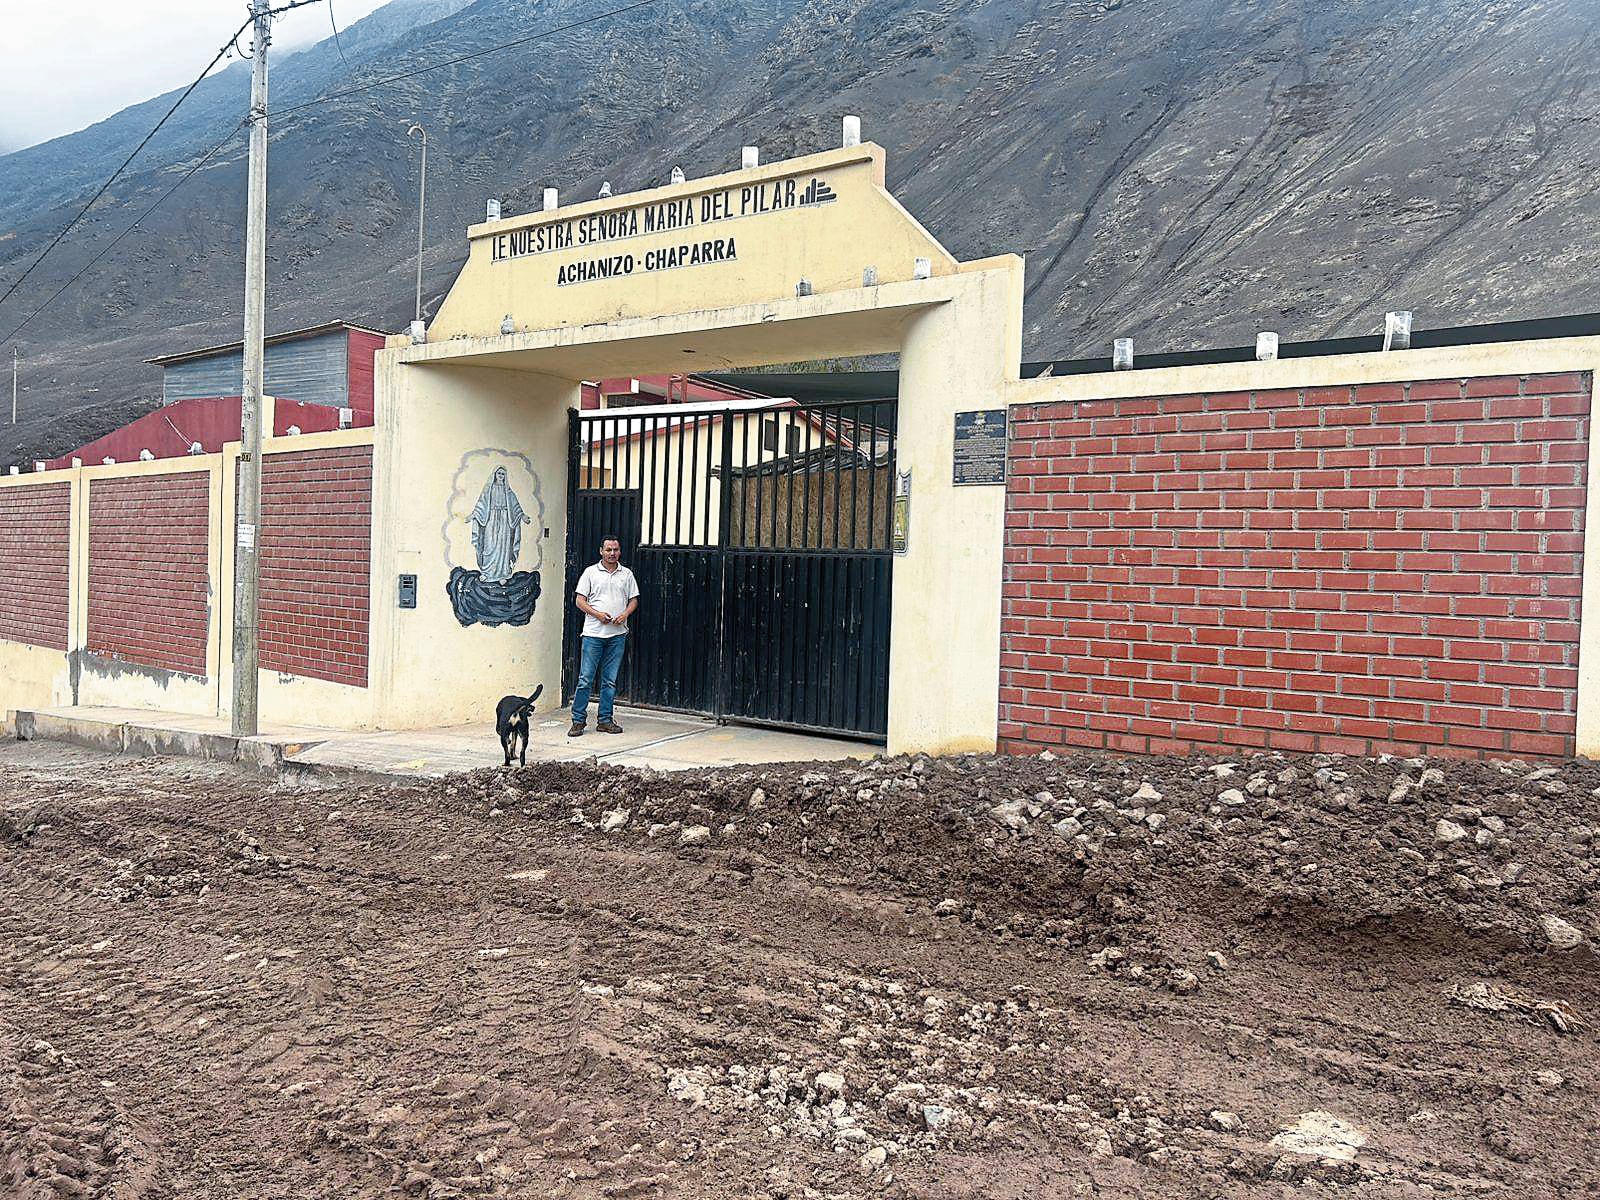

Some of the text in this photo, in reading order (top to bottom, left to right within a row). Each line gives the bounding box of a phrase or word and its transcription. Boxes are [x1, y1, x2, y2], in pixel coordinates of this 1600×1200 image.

[509, 222, 574, 257] NUESTRA
[644, 198, 694, 233] MARIA
[701, 191, 734, 223] DEL
[740, 179, 797, 215] PILAR
[557, 254, 634, 285] ACHANIZO
[645, 237, 737, 271] CHAPARRA
